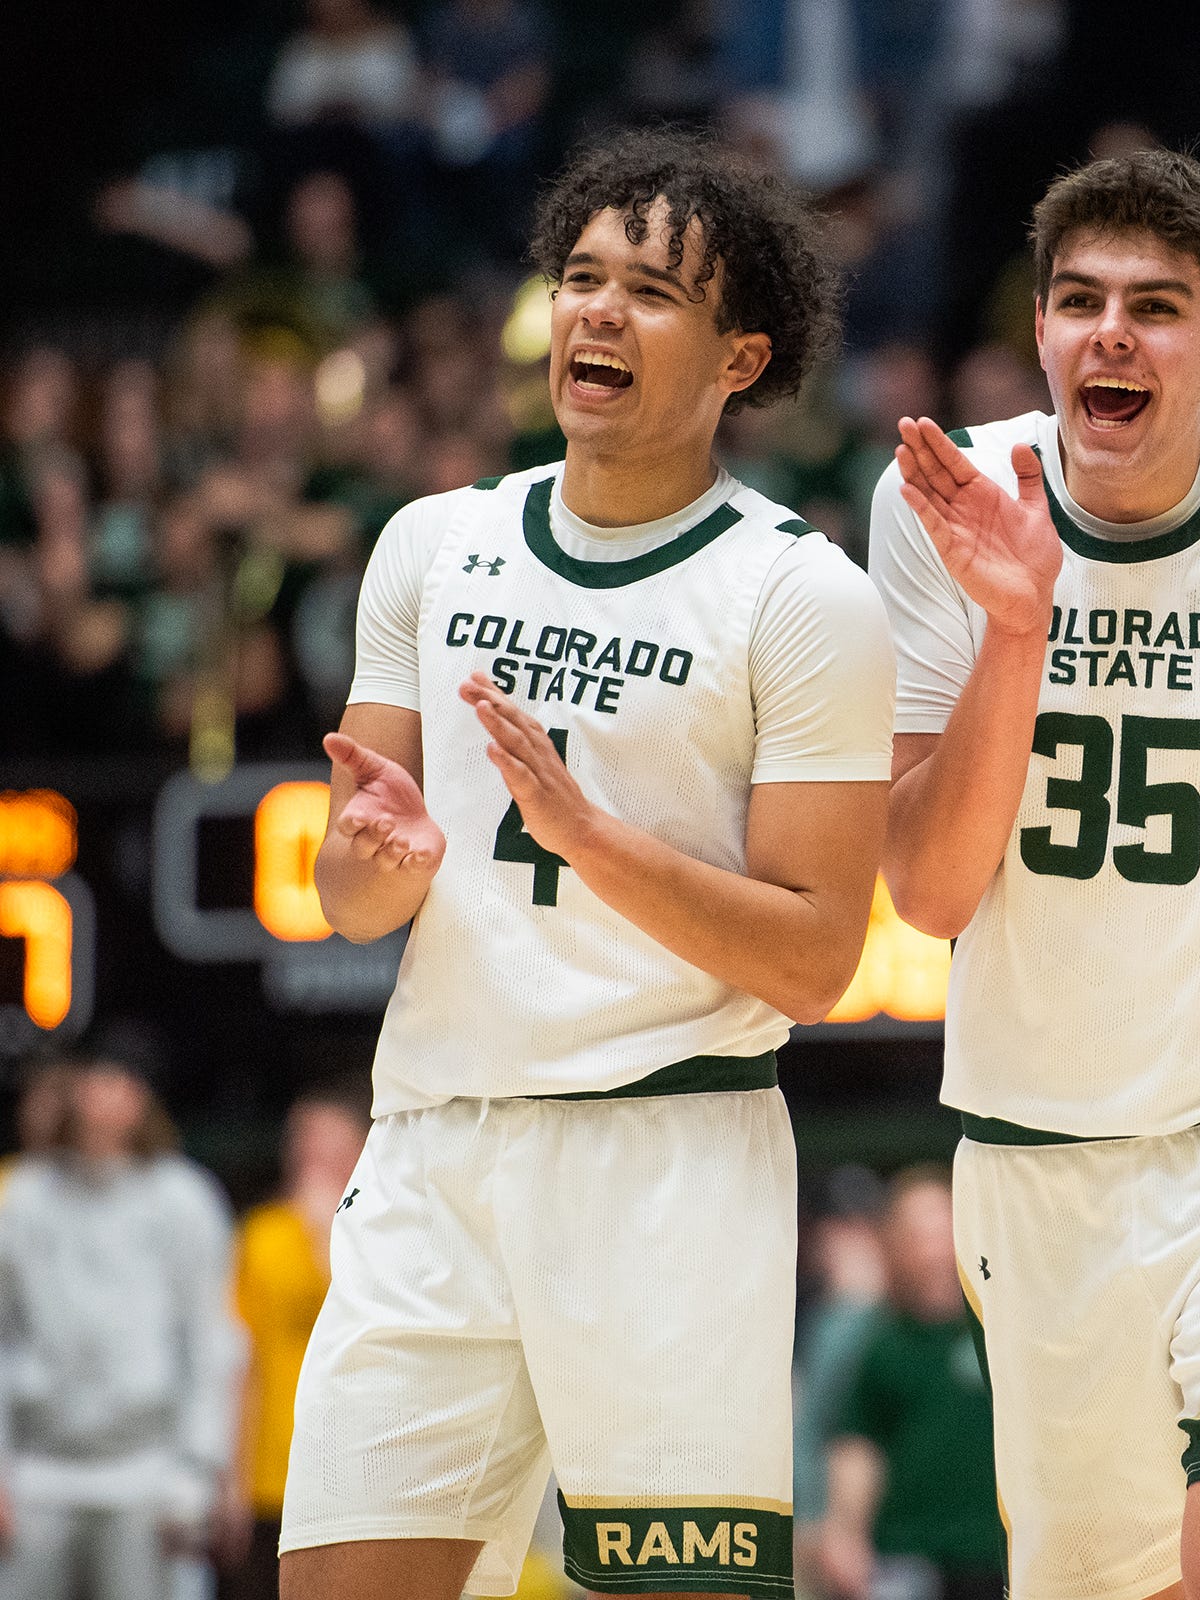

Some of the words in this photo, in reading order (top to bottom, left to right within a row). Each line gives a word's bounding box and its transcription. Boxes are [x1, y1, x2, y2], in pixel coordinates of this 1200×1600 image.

[446, 612, 694, 686] COLORADO
[1049, 649, 1194, 690] STATE
[492, 657, 625, 714] STATE
[493, 727, 571, 907] 4
[595, 1520, 758, 1567] RAMS
